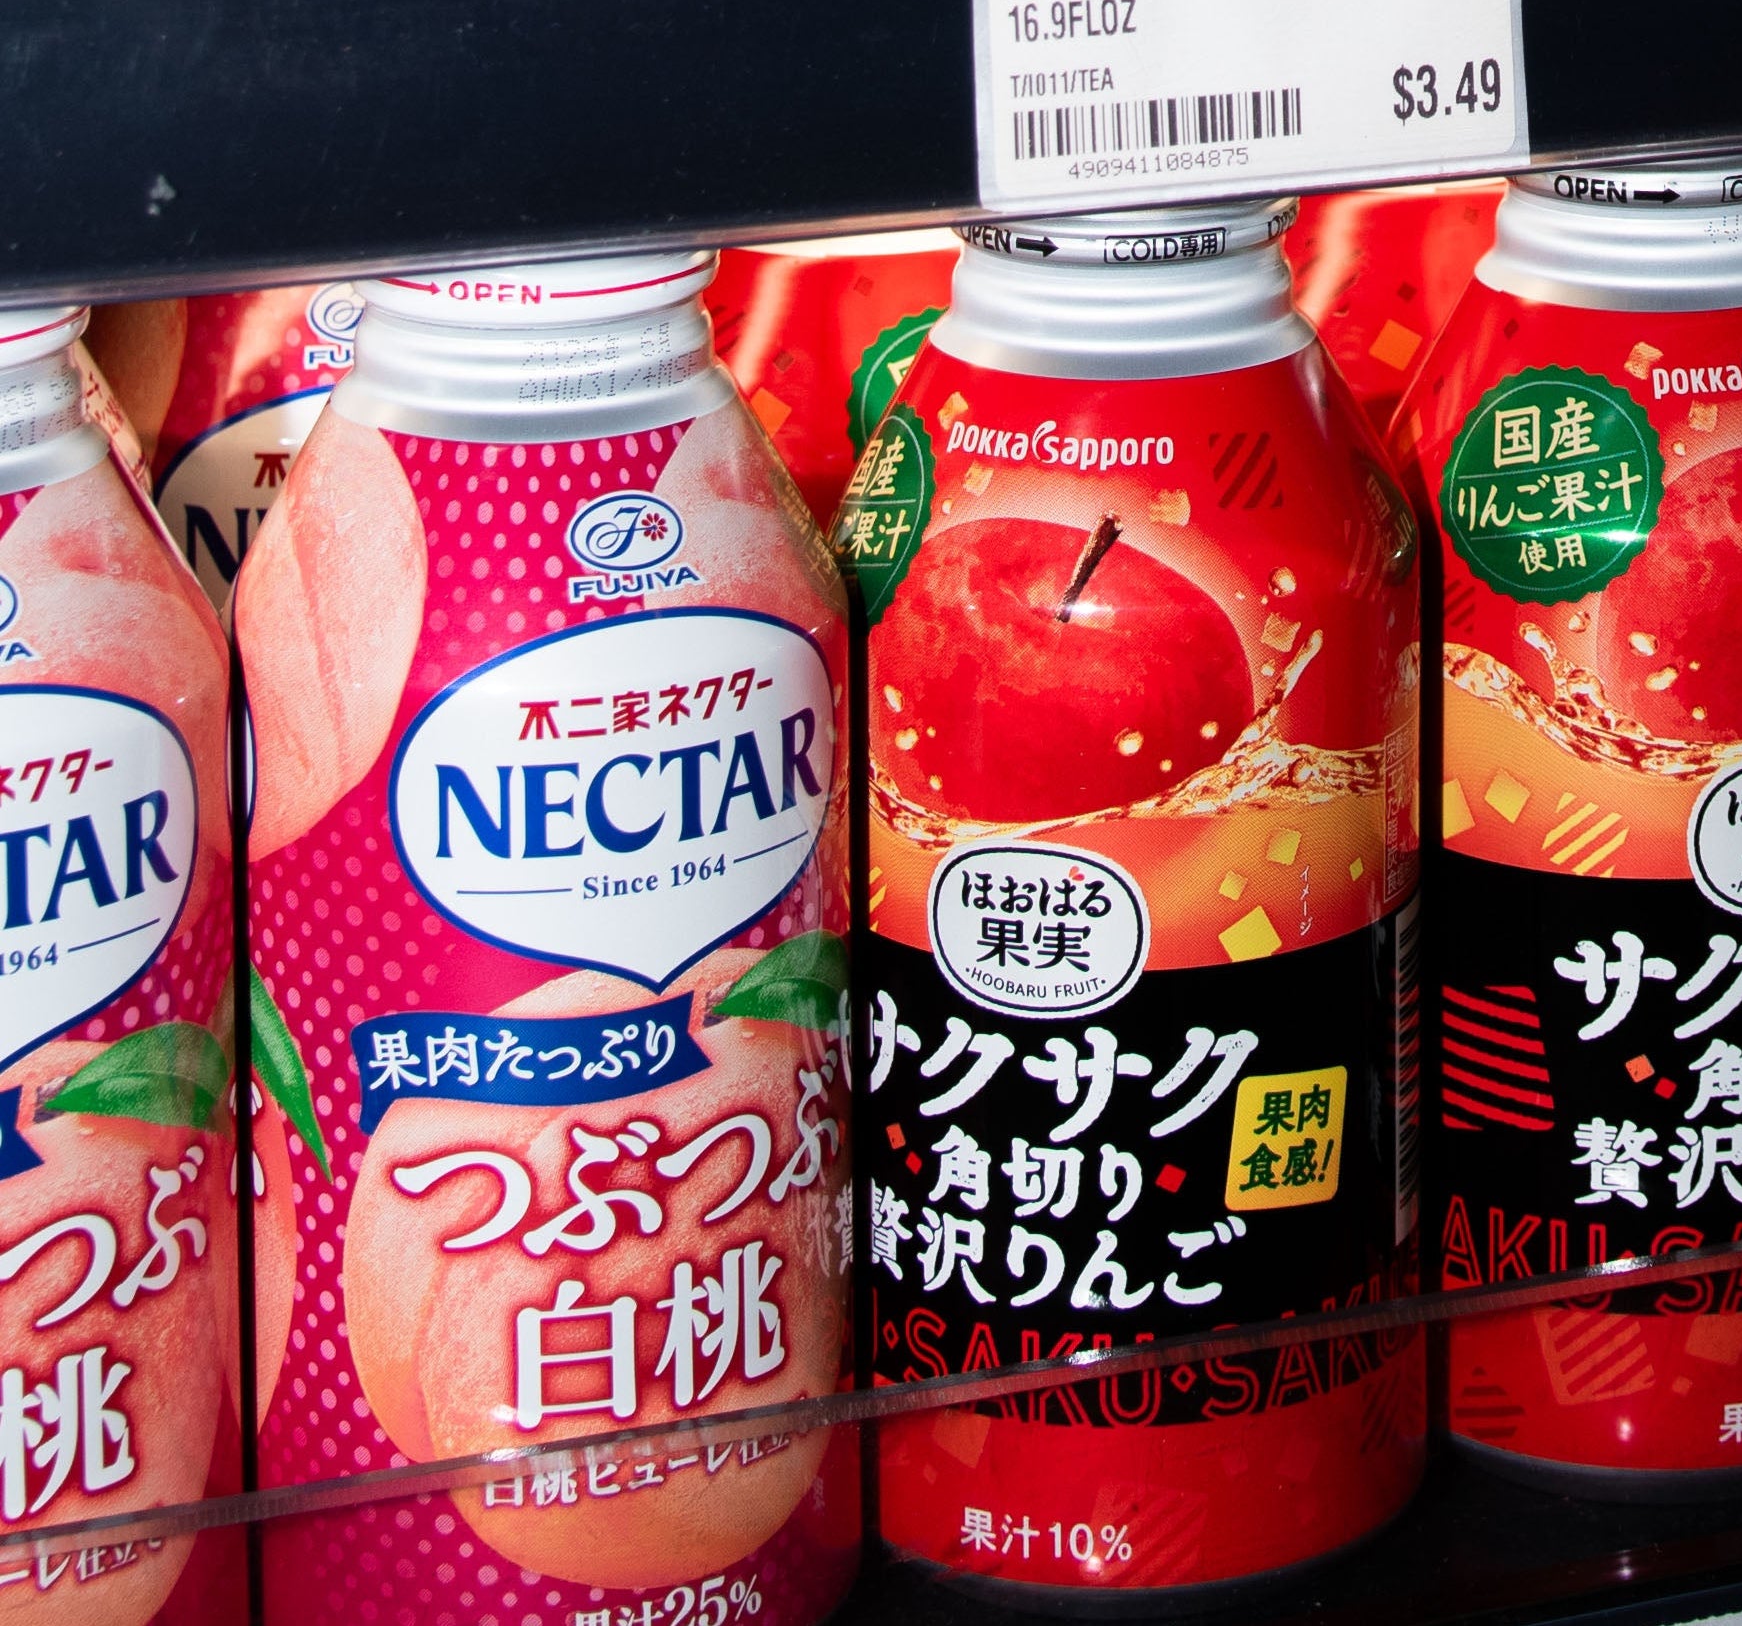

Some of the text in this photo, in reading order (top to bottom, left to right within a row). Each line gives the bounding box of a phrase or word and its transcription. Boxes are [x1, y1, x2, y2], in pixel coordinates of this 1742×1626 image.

[1392, 56, 1502, 127] $3.49
[1067, 147, 1250, 180] 4909411084875
[1554, 174, 1628, 205] OPEN
[1111, 232, 1222, 262] COLD専用
[448, 279, 543, 306] OPEN
[1492, 397, 1600, 466] 国産
[851, 434, 905, 500] 国産
[1457, 460, 1643, 533] りんご果汁
[573, 565, 700, 599] FUJIYA
[1518, 535, 1587, 577] 使用
[518, 666, 775, 743] 不二家ネクター
[435, 705, 823, 861] NECTAR
[583, 854, 727, 903] Since 1964
[976, 920, 1093, 971] 果実
[971, 968, 1102, 998] HOOBARU FRUIT
[369, 1018, 678, 1091] 果肉たっぷり
[1255, 1082, 1333, 1136] 果肉
[393, 1070, 841, 1257] つぶつぶ
[932, 1124, 1143, 1222] 角切り
[517, 1240, 786, 1432] 白桃
[961, 1505, 1133, 1563] 果汁10%
